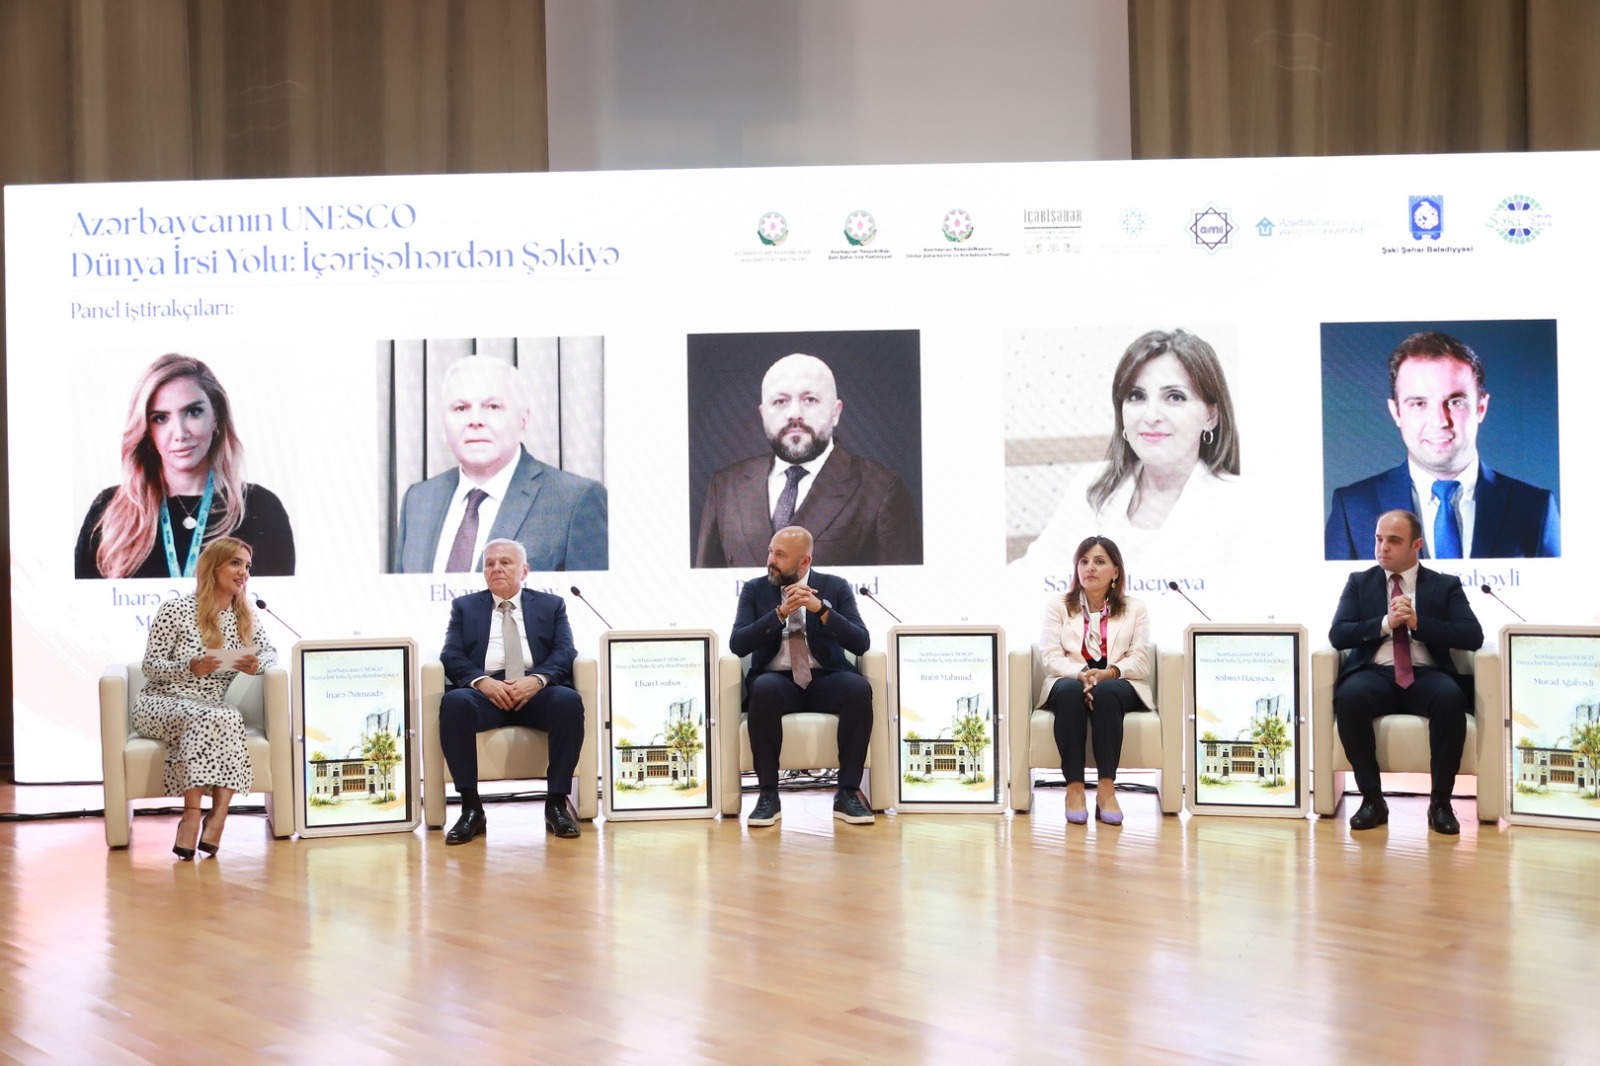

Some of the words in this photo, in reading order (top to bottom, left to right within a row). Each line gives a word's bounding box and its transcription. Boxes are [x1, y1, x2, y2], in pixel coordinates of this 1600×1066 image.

[70, 207, 273, 240] Azərbaycanın
[281, 203, 417, 231] UNESCO
[72, 251, 167, 283] Dünya
[174, 243, 218, 275] İrsi
[226, 245, 296, 274] Yolu:
[304, 239, 515, 279] İçərişəhərdən
[522, 237, 620, 276] Şəkiyə
[72, 299, 119, 319] Panel
[125, 298, 234, 322] iştirakçıları:
